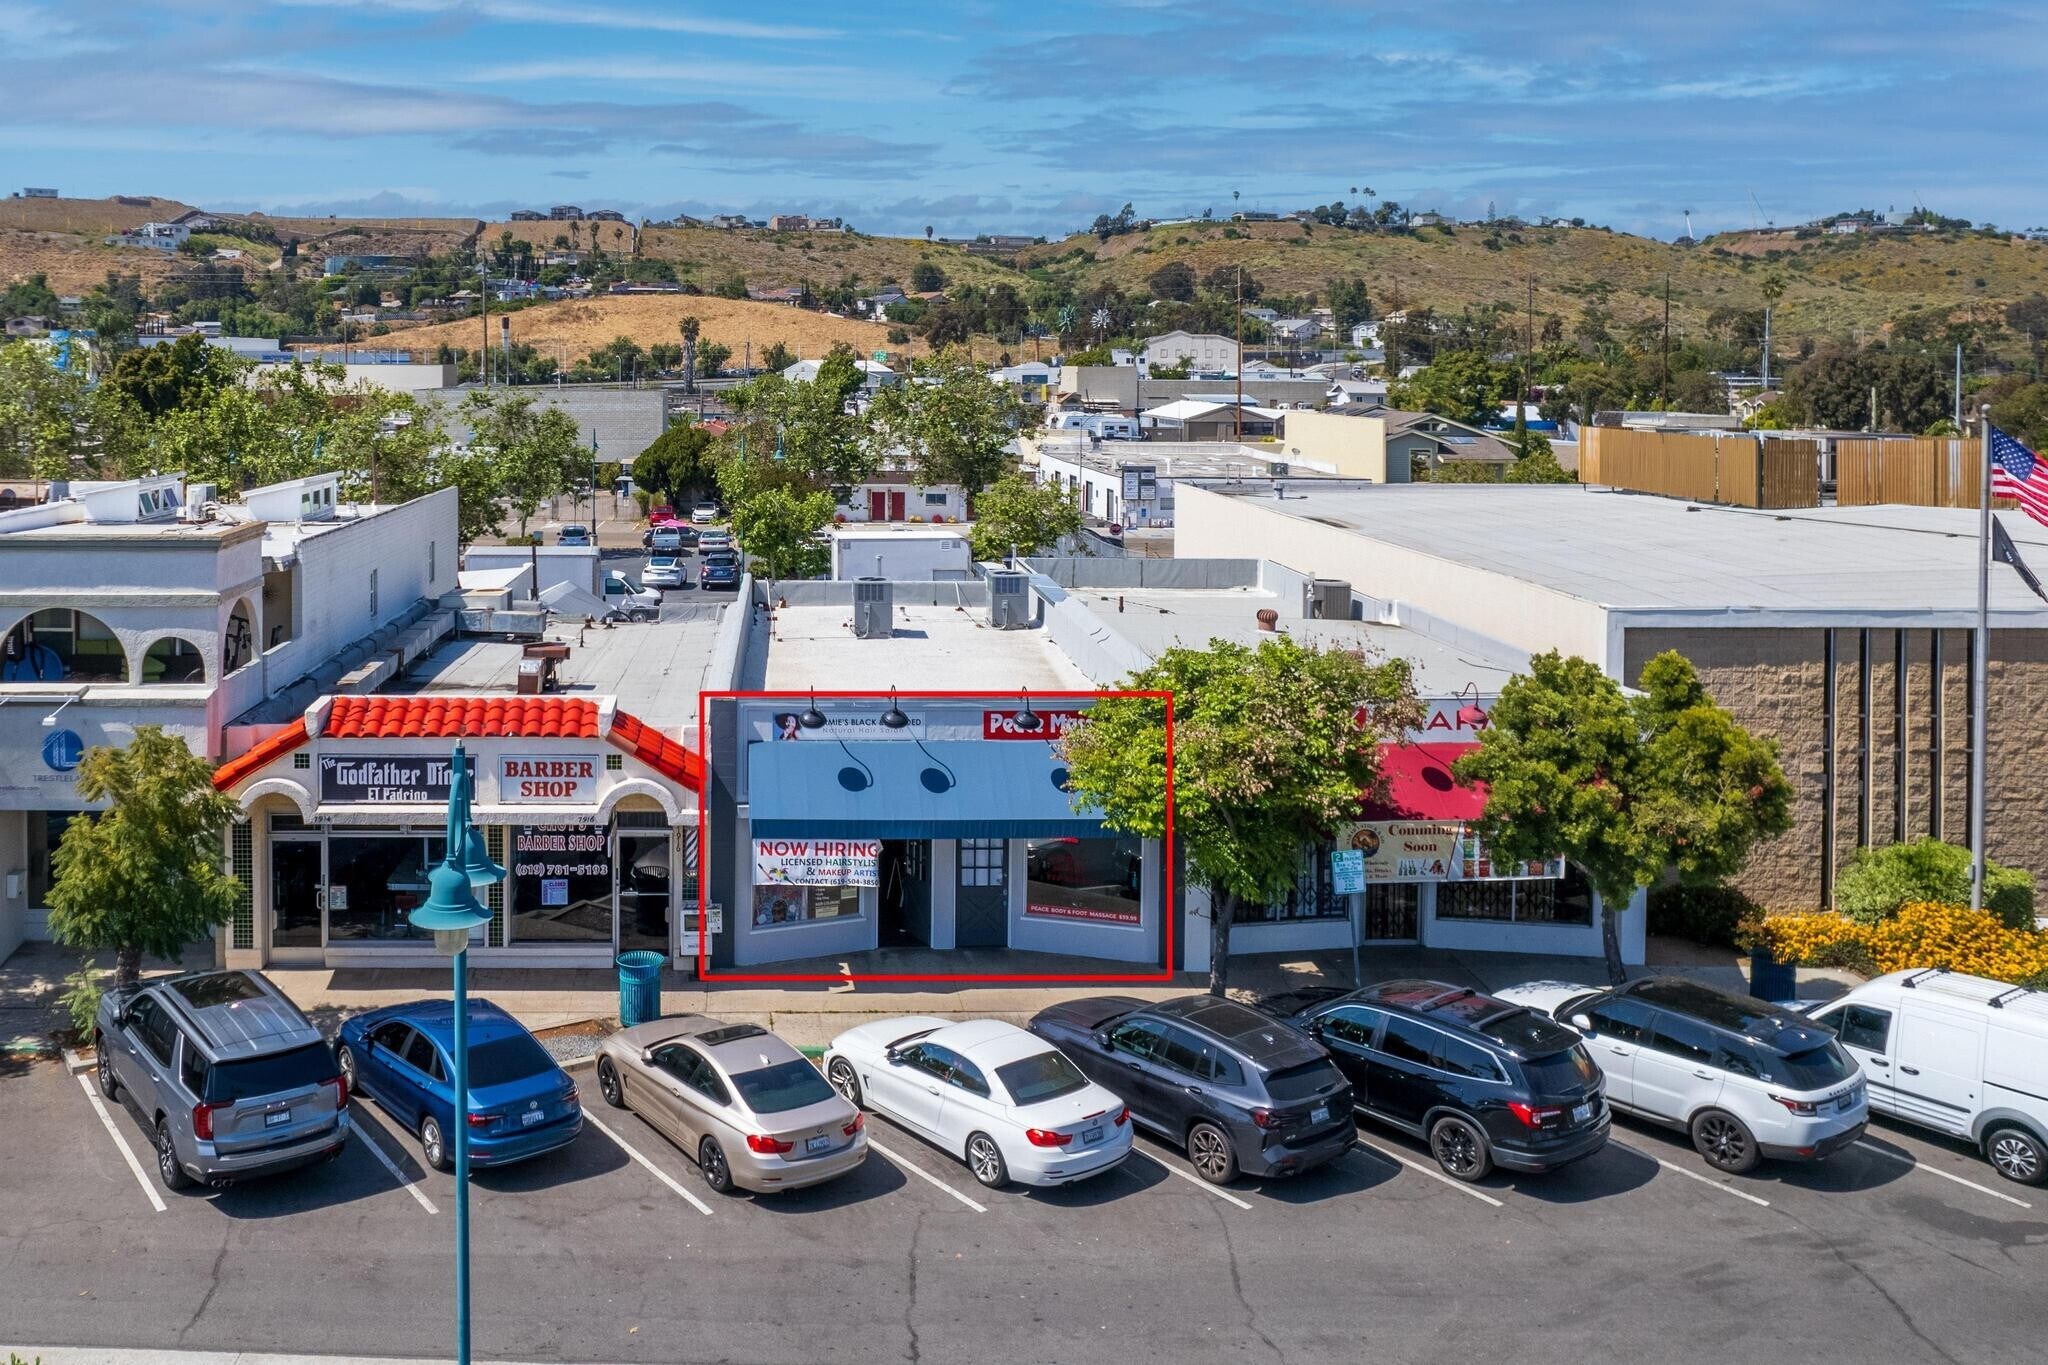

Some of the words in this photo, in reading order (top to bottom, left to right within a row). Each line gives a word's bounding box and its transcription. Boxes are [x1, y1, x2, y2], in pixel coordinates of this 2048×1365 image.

[852, 718, 876, 726] BLACK
[322, 758, 337, 770] The
[336, 762, 420, 786] Godfather
[426, 762, 474, 786] Dinr
[505, 761, 594, 778] BARBER
[383, 787, 428, 800] Padrino
[520, 781, 578, 797] SHOP
[1388, 824, 1453, 836] Comming
[517, 835, 566, 851] BARBER
[568, 835, 605, 851] SHOP
[760, 841, 808, 856] NOW
[814, 841, 878, 857] HIRING
[1403, 841, 1437, 852] Soon
[781, 858, 822, 866] LICENSED
[825, 858, 877, 867] HAIRSTYLIS
[516, 863, 545, 877] (619)
[806, 867, 815, 876] &
[818, 869, 851, 877] MAKEUP
[854, 869, 877, 877] ARTIS
